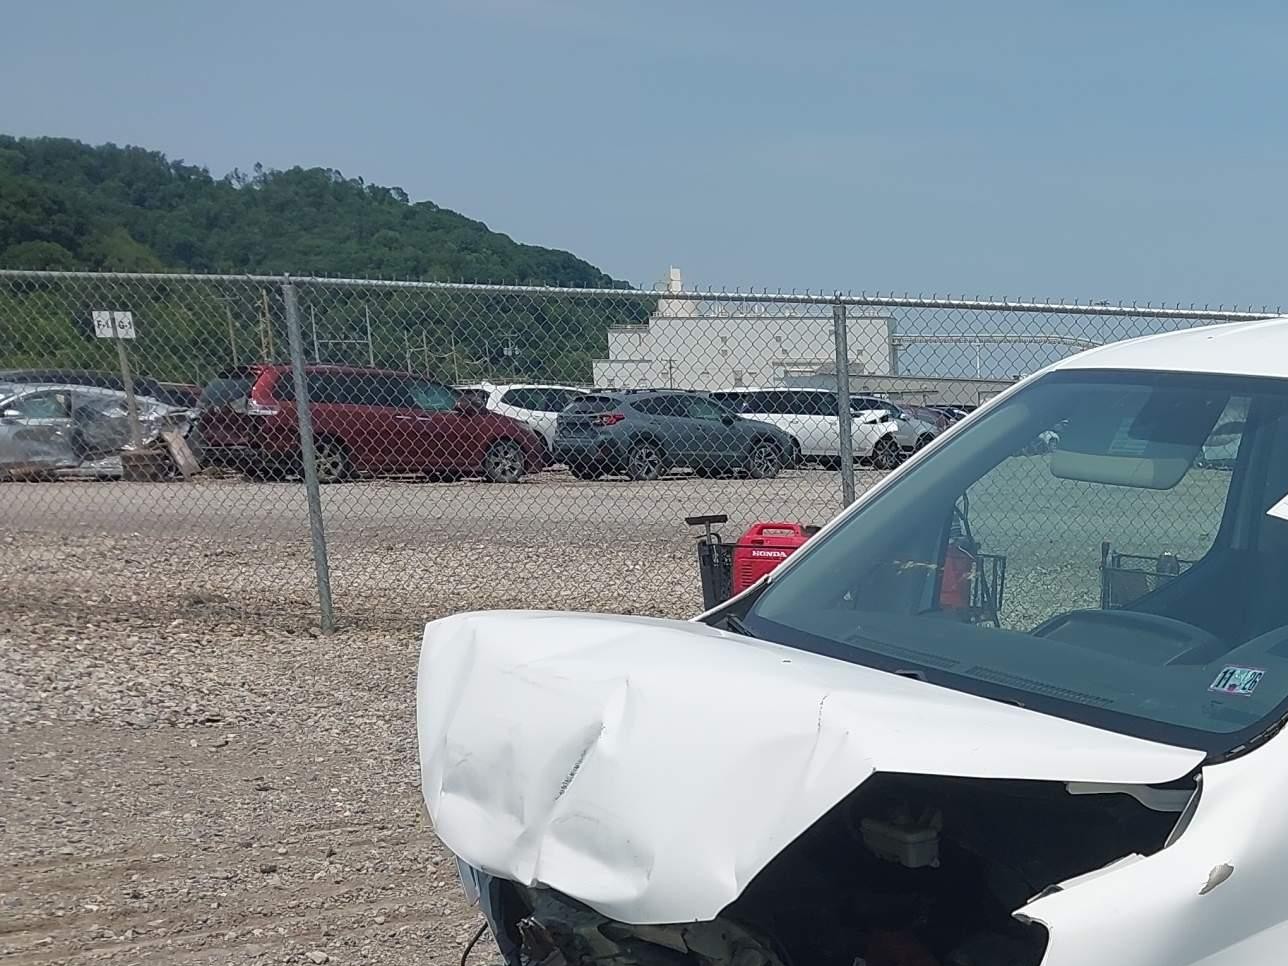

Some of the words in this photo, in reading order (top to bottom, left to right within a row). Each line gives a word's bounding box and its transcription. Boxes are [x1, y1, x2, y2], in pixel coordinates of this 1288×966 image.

[752, 550, 787, 558] HONDA
[1215, 669, 1236, 688] 11
[1241, 671, 1262, 691] 26
